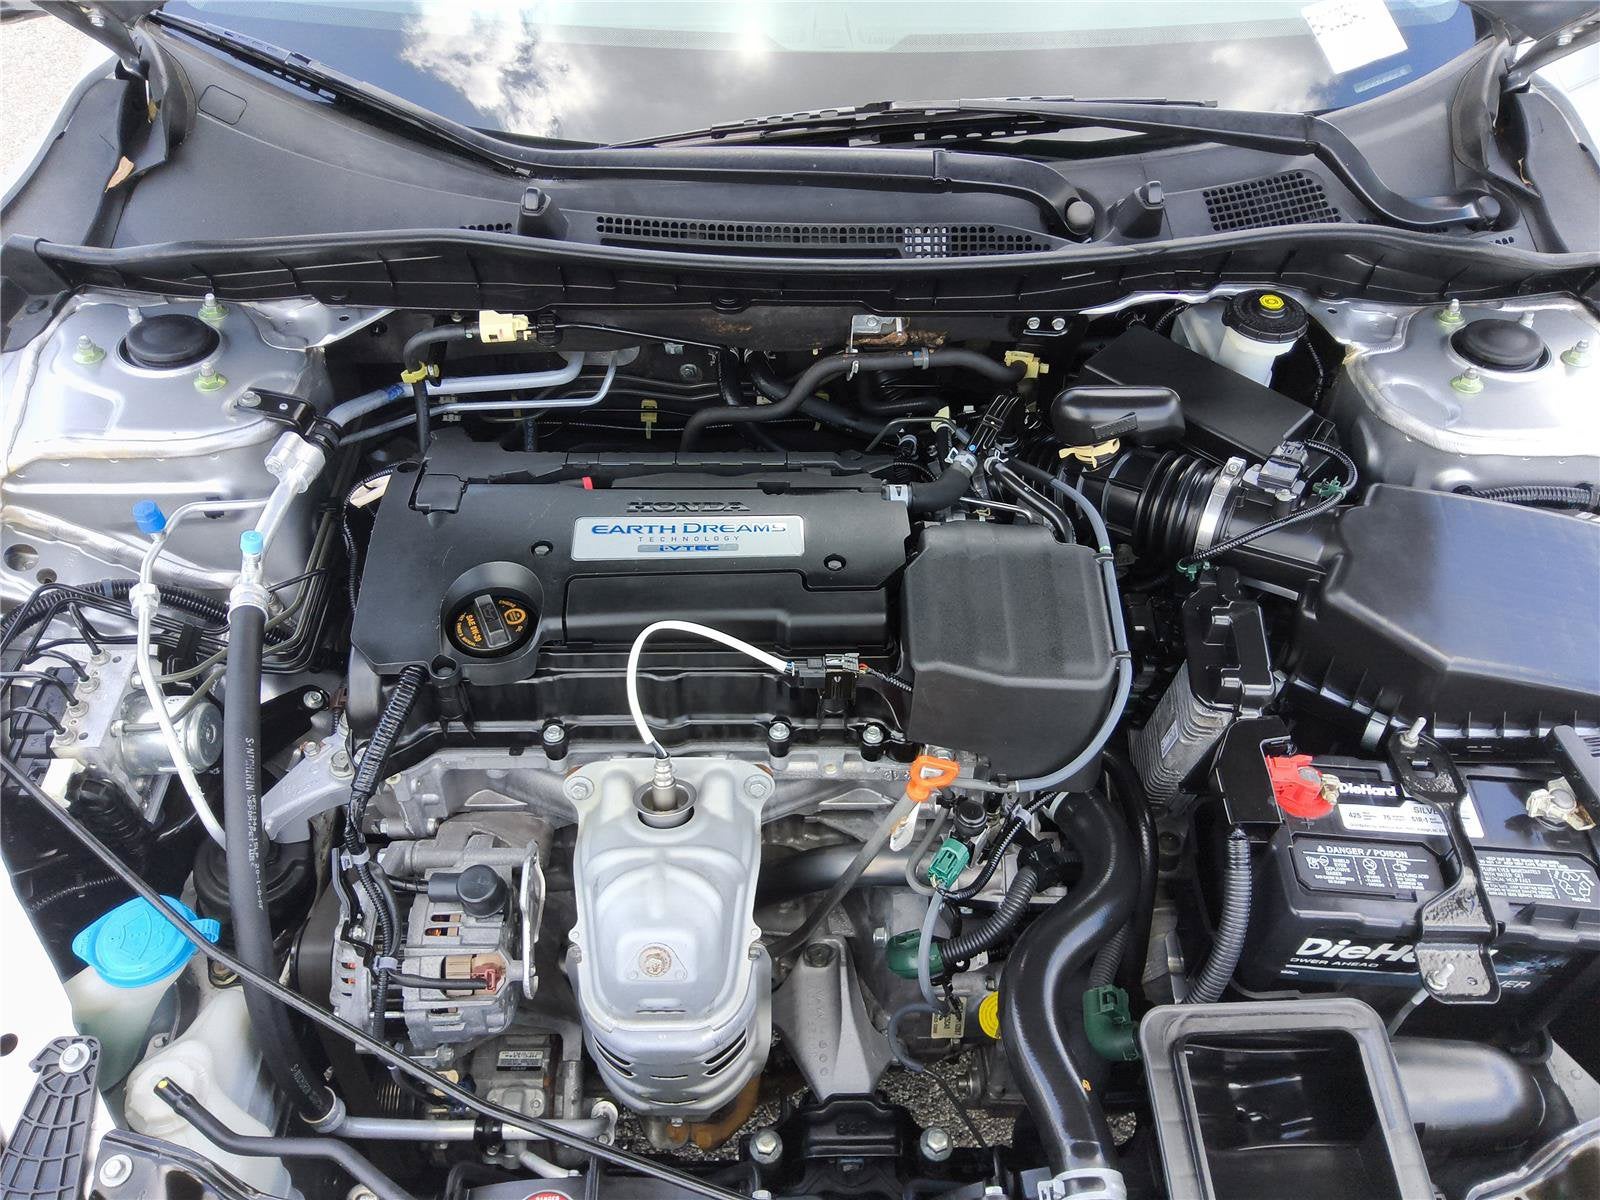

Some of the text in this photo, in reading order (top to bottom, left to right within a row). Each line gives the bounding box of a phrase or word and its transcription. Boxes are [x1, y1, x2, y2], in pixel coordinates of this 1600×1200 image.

[626, 501, 751, 513] HONDA
[591, 522, 787, 535] EARTH DREAMS
[1340, 782, 1397, 797] DieHard
[1326, 846, 1365, 856] DANGER
[1373, 849, 1408, 858] POISON
[1331, 960, 1379, 968] AHEAD
